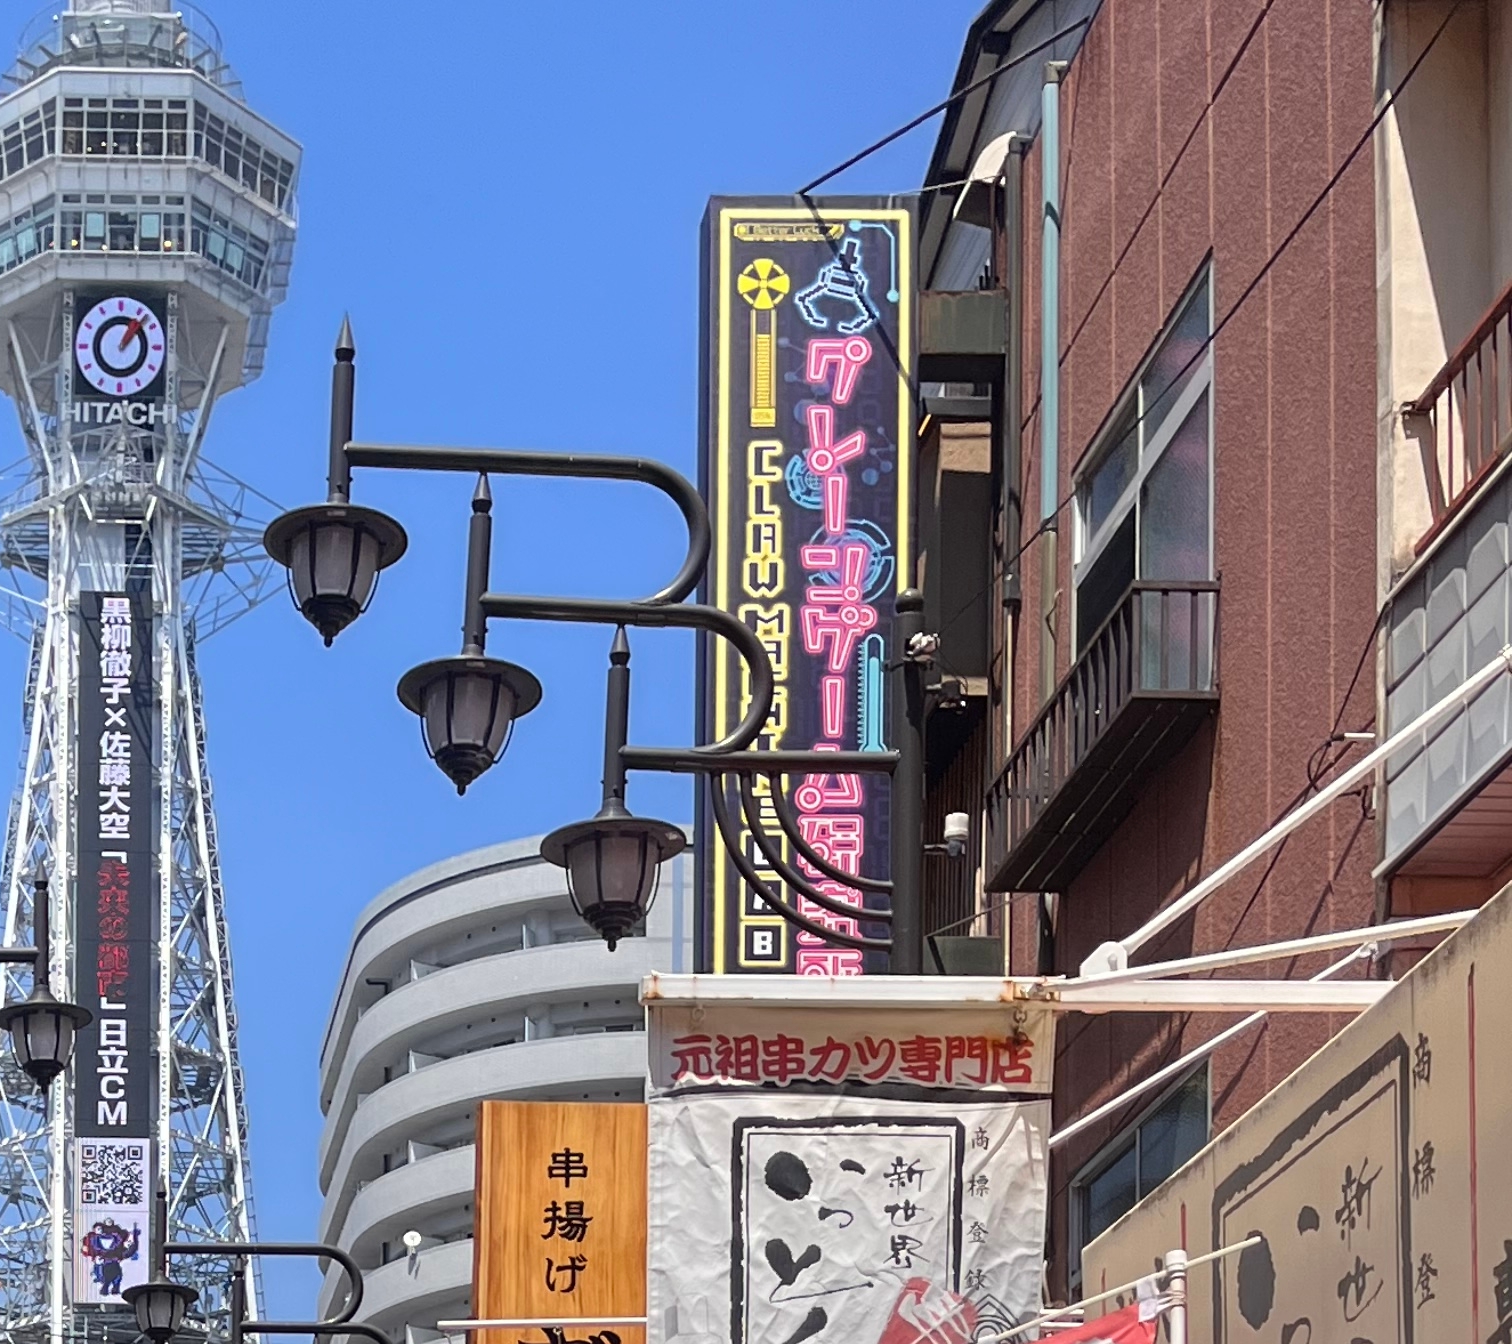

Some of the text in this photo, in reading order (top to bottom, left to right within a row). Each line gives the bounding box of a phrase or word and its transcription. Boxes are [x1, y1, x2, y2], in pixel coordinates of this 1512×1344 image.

[61, 401, 178, 425] HITACHI
[671, 1032, 1035, 1084] 元祖串カツ専門店
[543, 1147, 594, 1294] 串揚げ
[883, 1156, 936, 1269] 新世界
[964, 1126, 991, 1291] 商標登録
